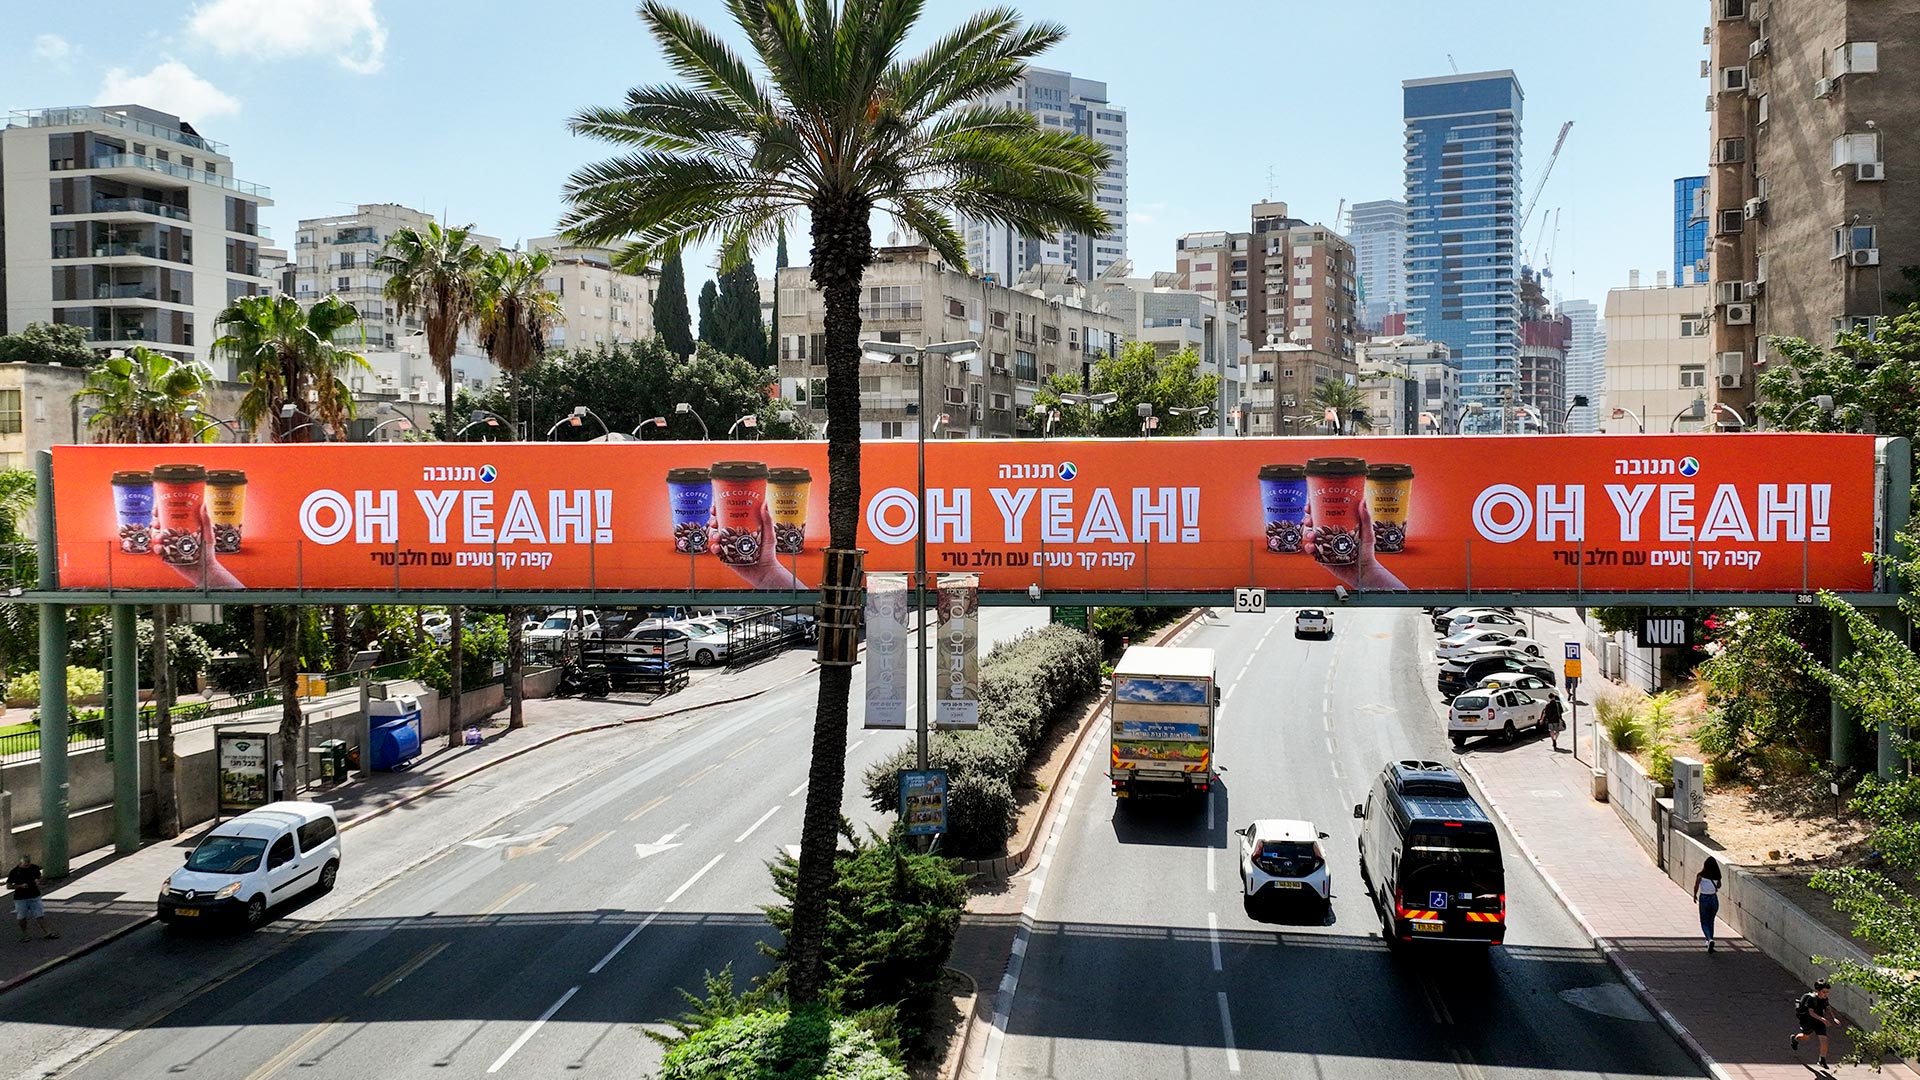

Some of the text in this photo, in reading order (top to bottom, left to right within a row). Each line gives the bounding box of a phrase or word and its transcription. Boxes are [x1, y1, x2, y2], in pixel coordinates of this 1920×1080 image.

[424, 467, 476, 481] תנובה
[999, 463, 1055, 479] תנובה
[1615, 459, 1675, 475] תנובה
[732, 490, 760, 500] COFFEE
[1278, 489, 1303, 497] COFFEE
[1328, 487, 1358, 498] COFFEE
[299, 488, 613, 545] OH YEAH!
[866, 487, 1201, 545] OH YEAH!
[1472, 483, 1832, 544] OH YEAH!
[370, 548, 553, 570] קפה קר טעים עם חלב טרי
[941, 548, 1136, 571] קפה קר טעים עם חלב טרי
[1552, 547, 1762, 570] קפה קר טעים עם חלב טרי
[1238, 593, 1262, 608] 5.0
[1797, 594, 1813, 604] 306
[1646, 619, 1685, 644] NUR
